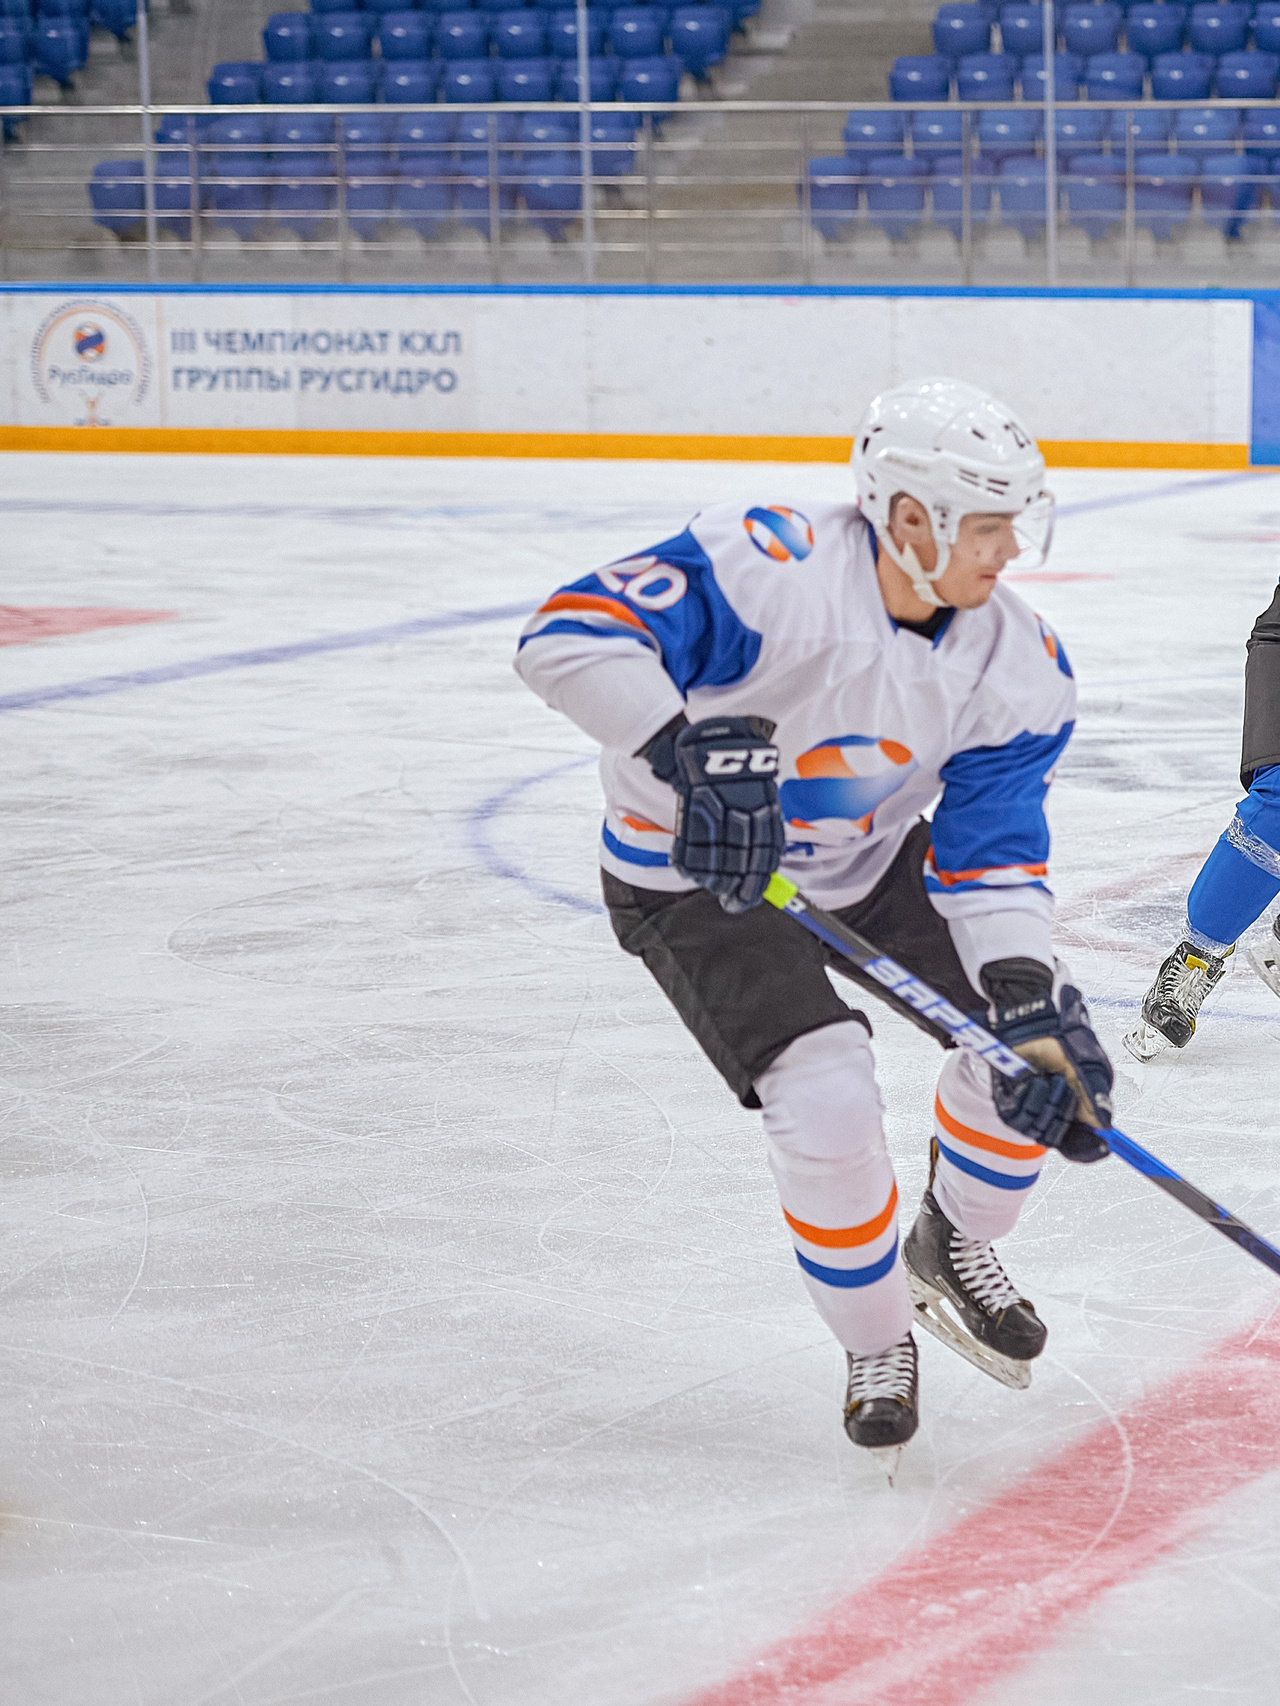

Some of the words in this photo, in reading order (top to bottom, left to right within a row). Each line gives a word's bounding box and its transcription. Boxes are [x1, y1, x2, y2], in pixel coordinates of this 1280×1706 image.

[203, 330, 390, 354] ЧЕМПИОНАТ
[400, 330, 462, 354] КХЛ
[171, 367, 292, 393] ГРУППЫ
[299, 368, 459, 396] РУСГИДРО
[595, 554, 688, 611] 20
[704, 748, 778, 776] CC
[1003, 998, 1047, 1022] CCM
